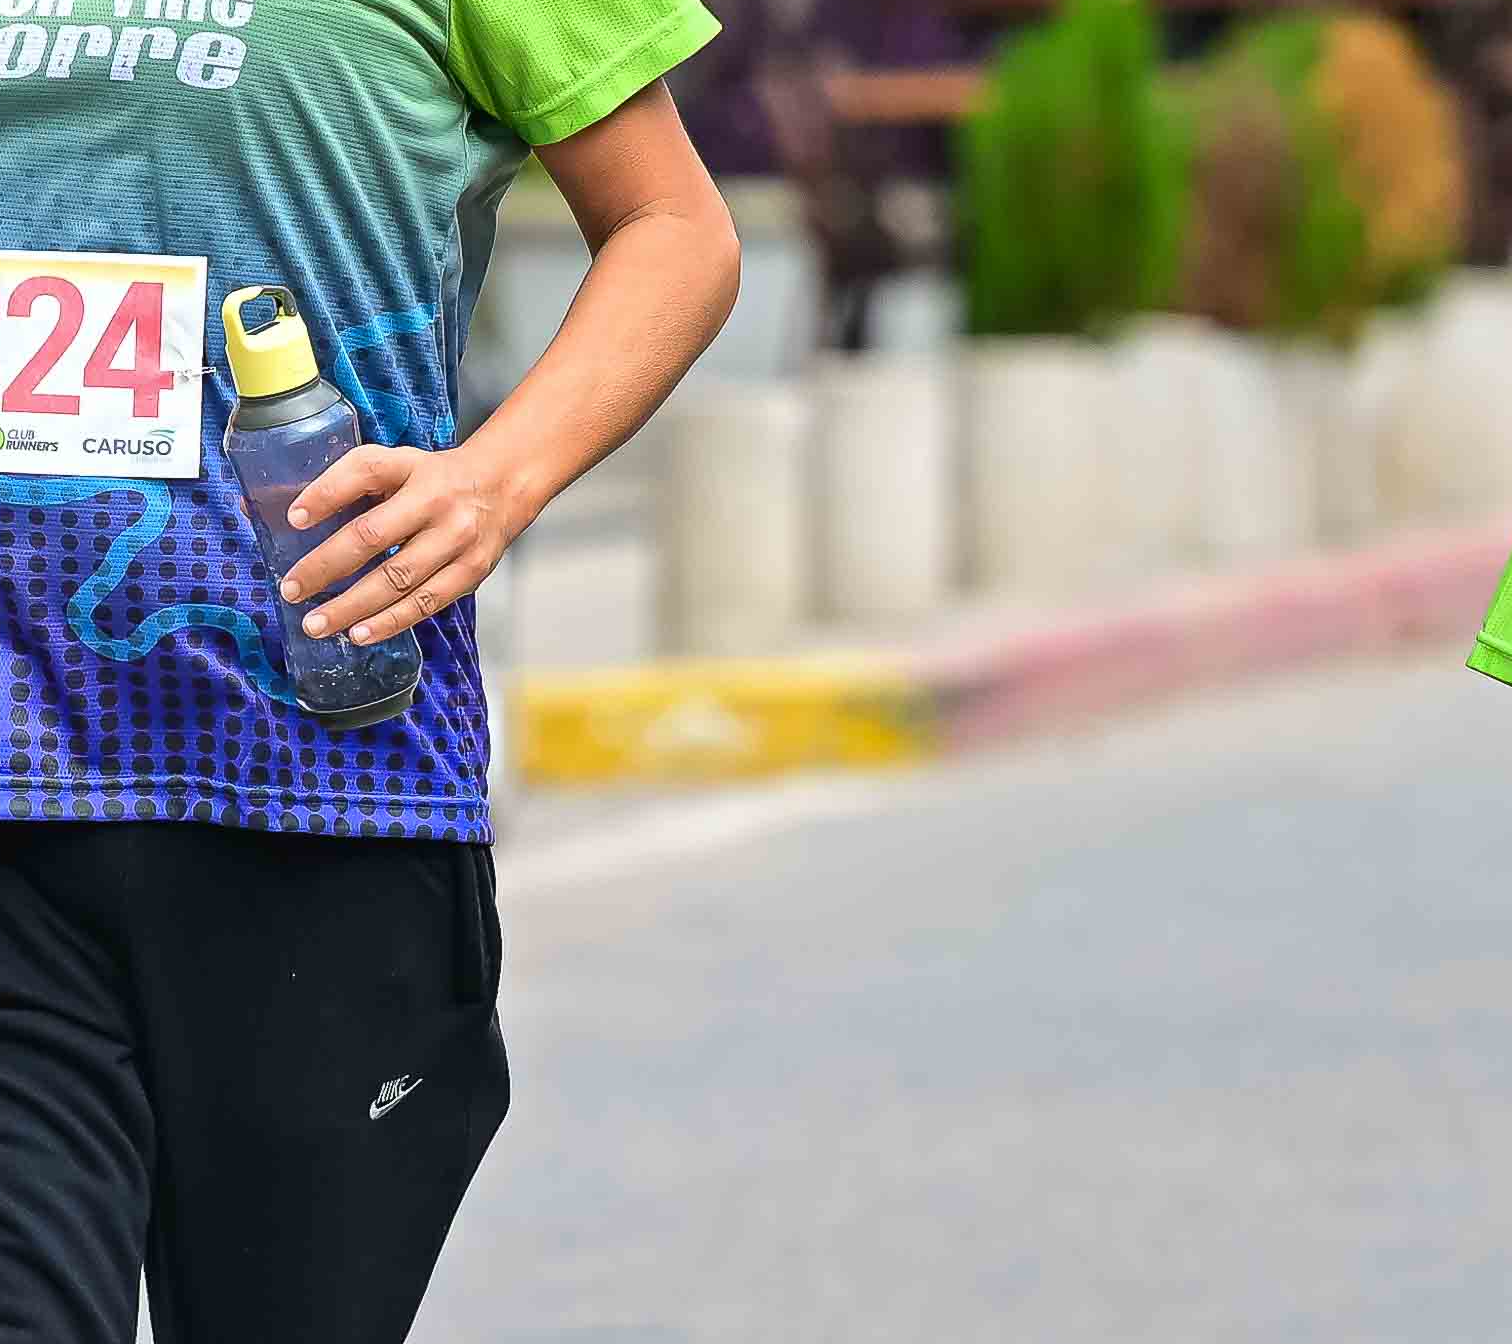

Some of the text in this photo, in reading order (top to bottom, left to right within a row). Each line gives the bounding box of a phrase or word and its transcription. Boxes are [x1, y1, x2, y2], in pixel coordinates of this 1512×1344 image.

[7, 428, 35, 440] CLUB
[5, 440, 59, 452] RUNNER'S
[82, 437, 172, 456] CARUSO
[376, 1074, 411, 1105] NIKE
